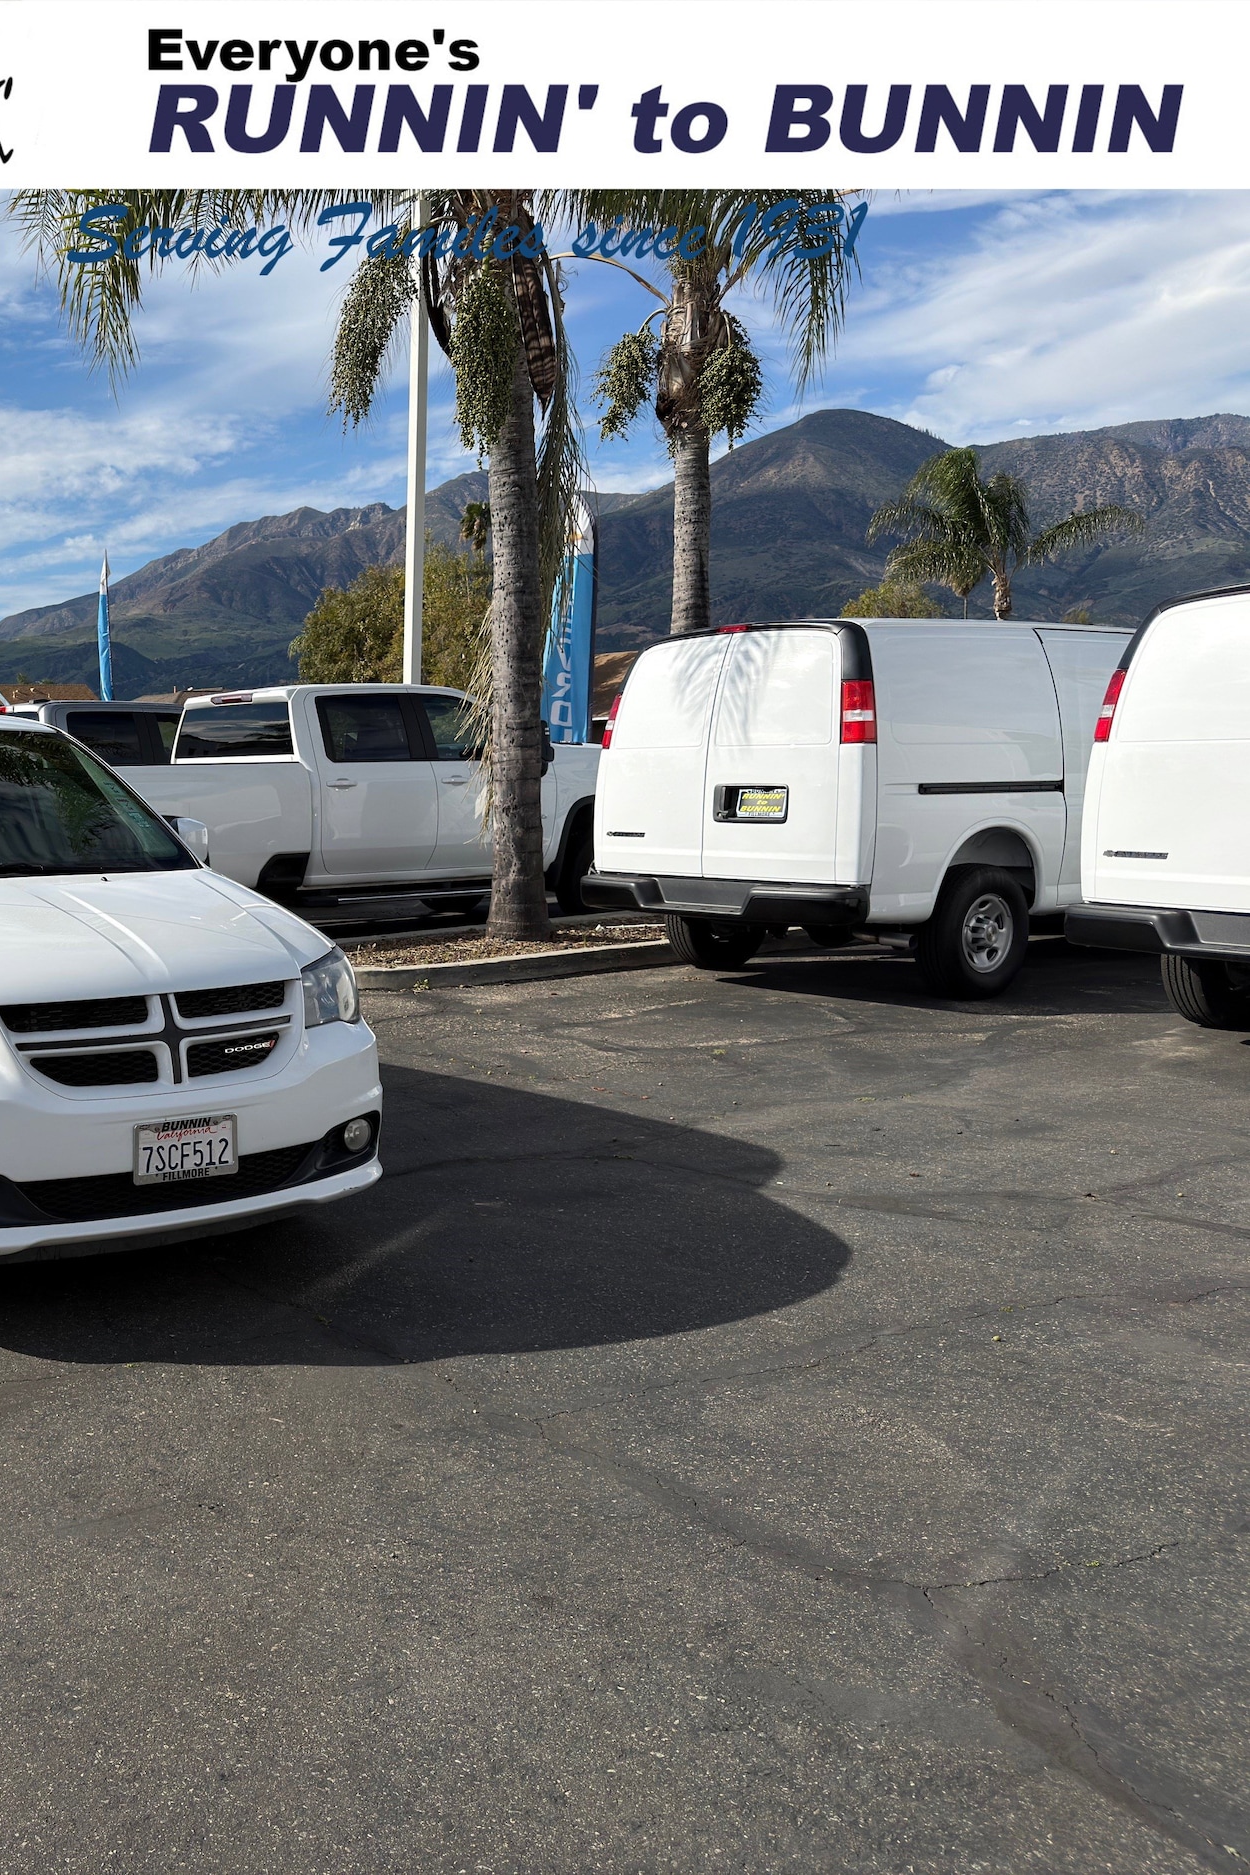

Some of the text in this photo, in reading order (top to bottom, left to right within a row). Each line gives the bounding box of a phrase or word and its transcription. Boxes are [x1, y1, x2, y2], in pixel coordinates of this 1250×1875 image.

[224, 1041, 270, 1053] DODGE
[161, 1116, 211, 1132] BUNNIN
[156, 1126, 216, 1141] California
[142, 1137, 229, 1173] 7SCF512
[162, 1167, 209, 1180] FILLMORE
